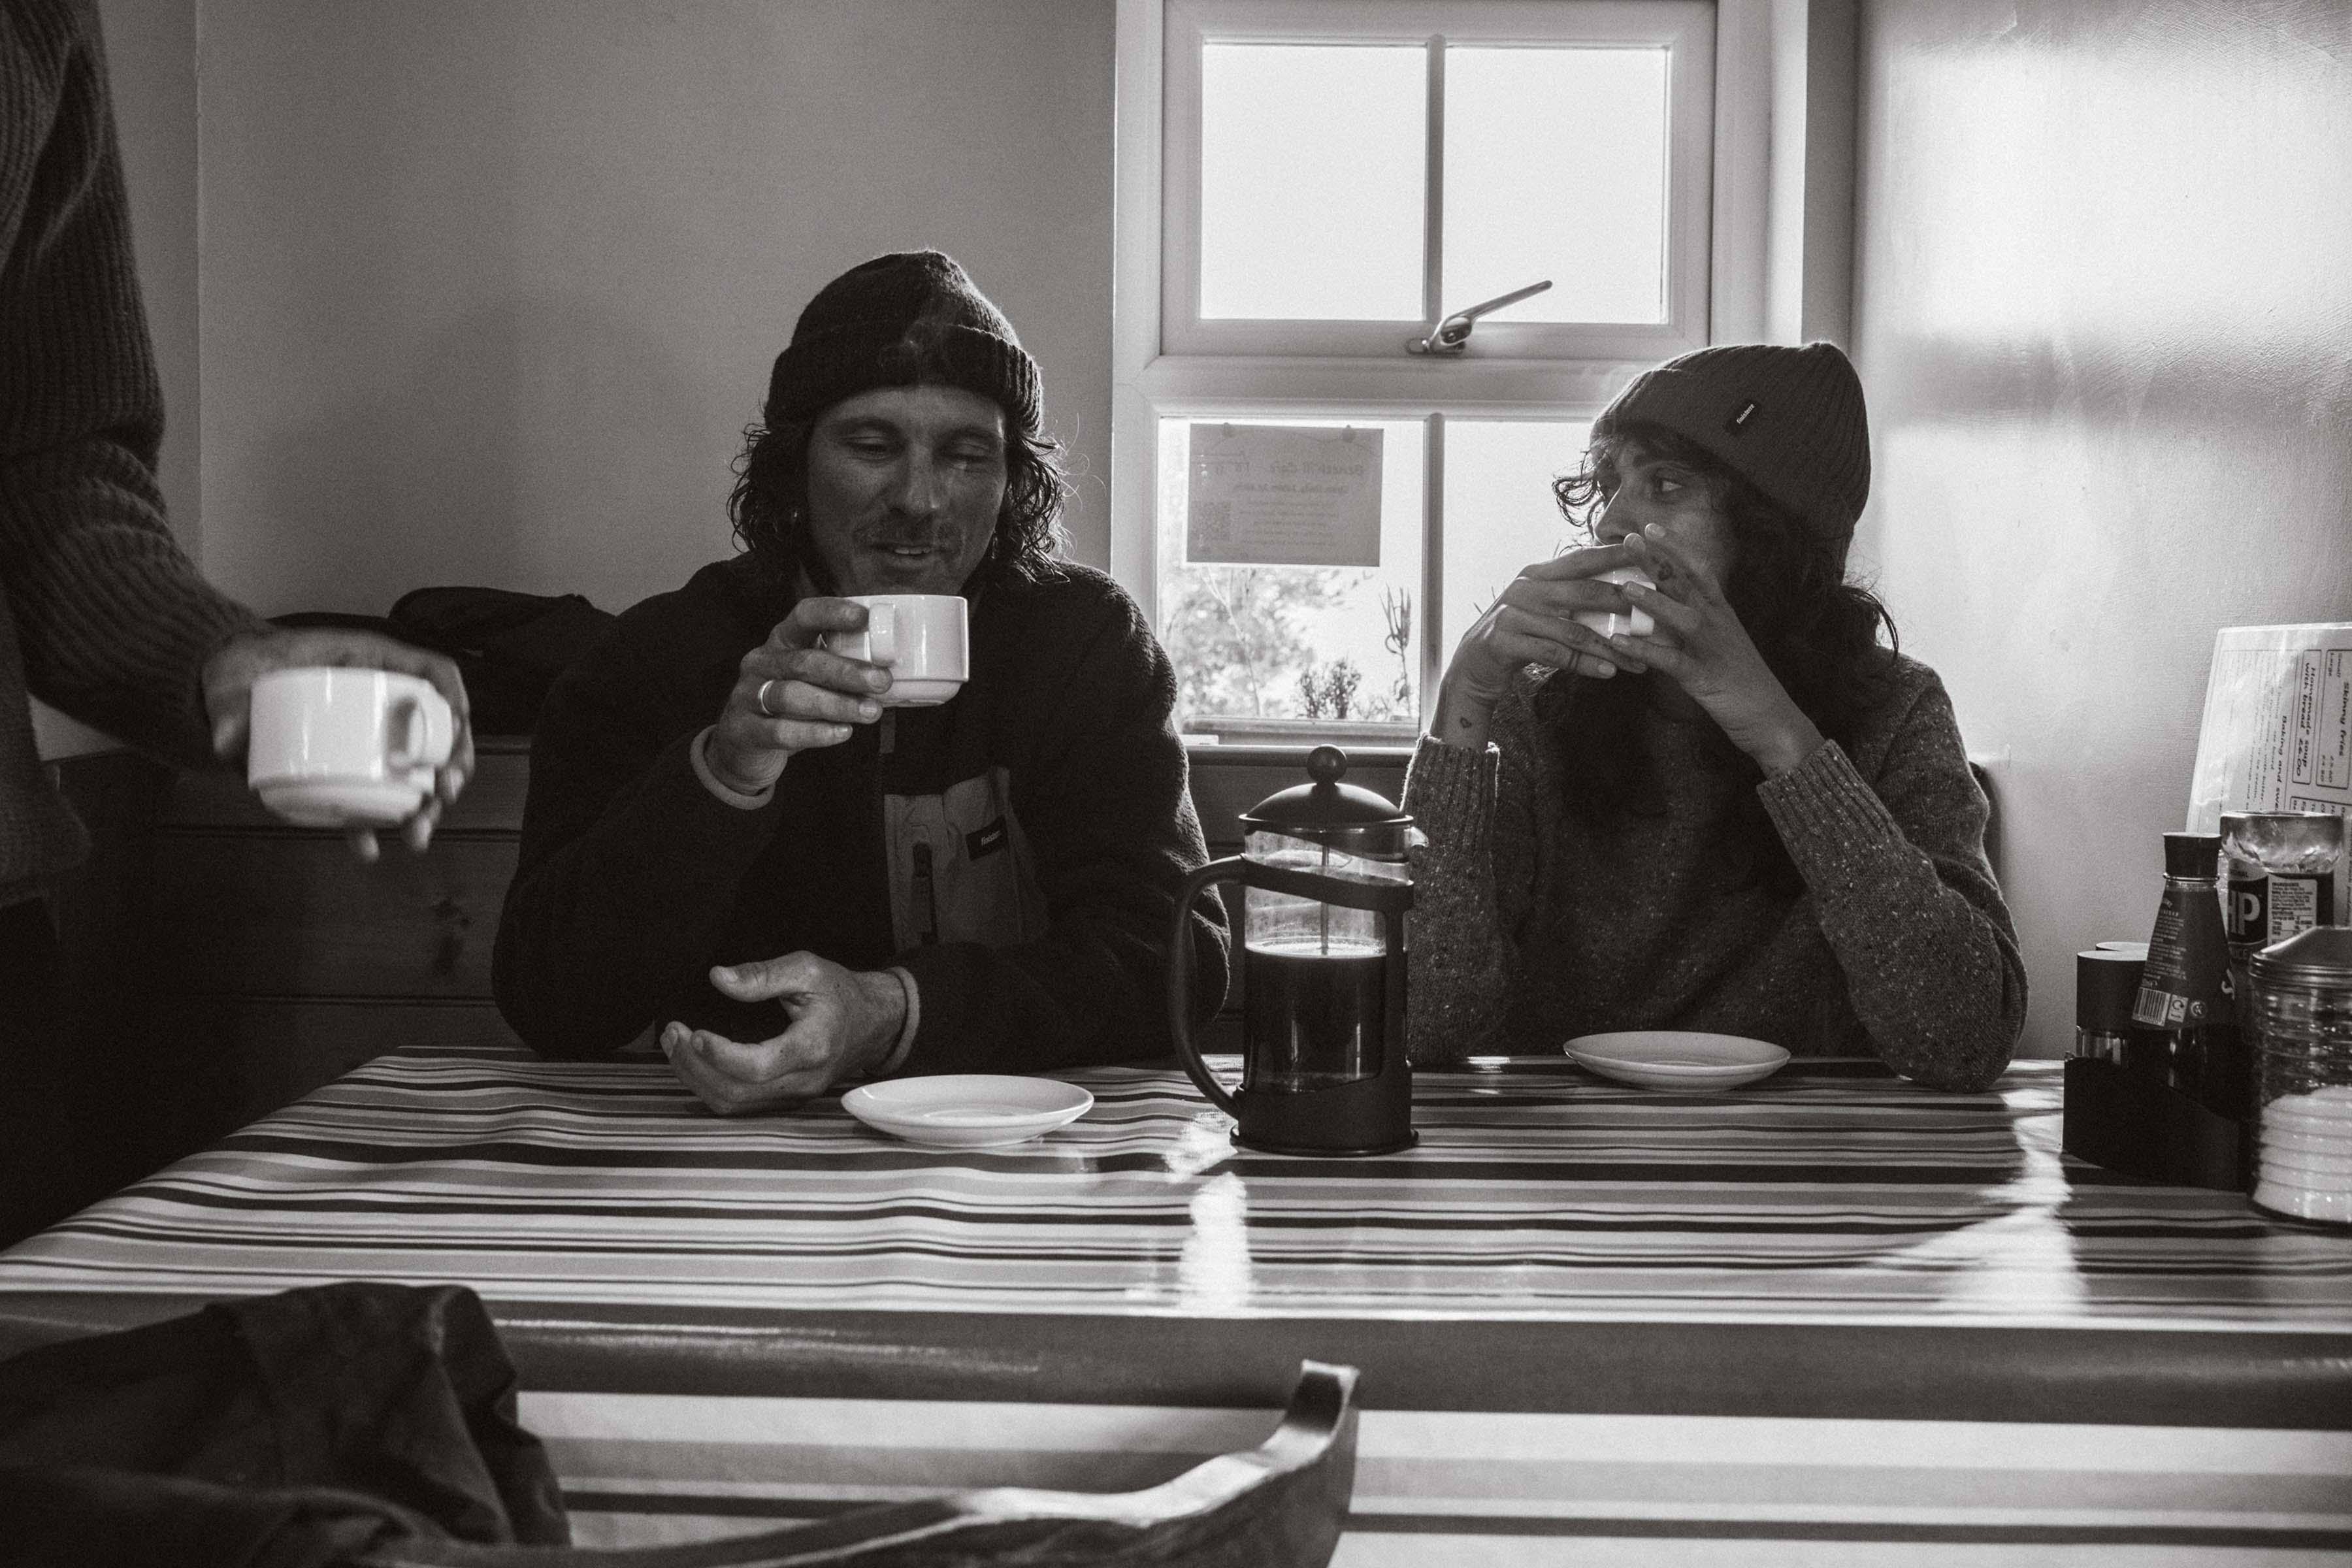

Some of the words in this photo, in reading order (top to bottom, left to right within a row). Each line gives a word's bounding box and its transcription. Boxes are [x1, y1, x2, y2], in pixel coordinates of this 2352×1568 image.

[2305, 667, 2315, 736] Homemade
[2340, 682, 2349, 725] Skinny
[2228, 889, 2261, 936] HP
